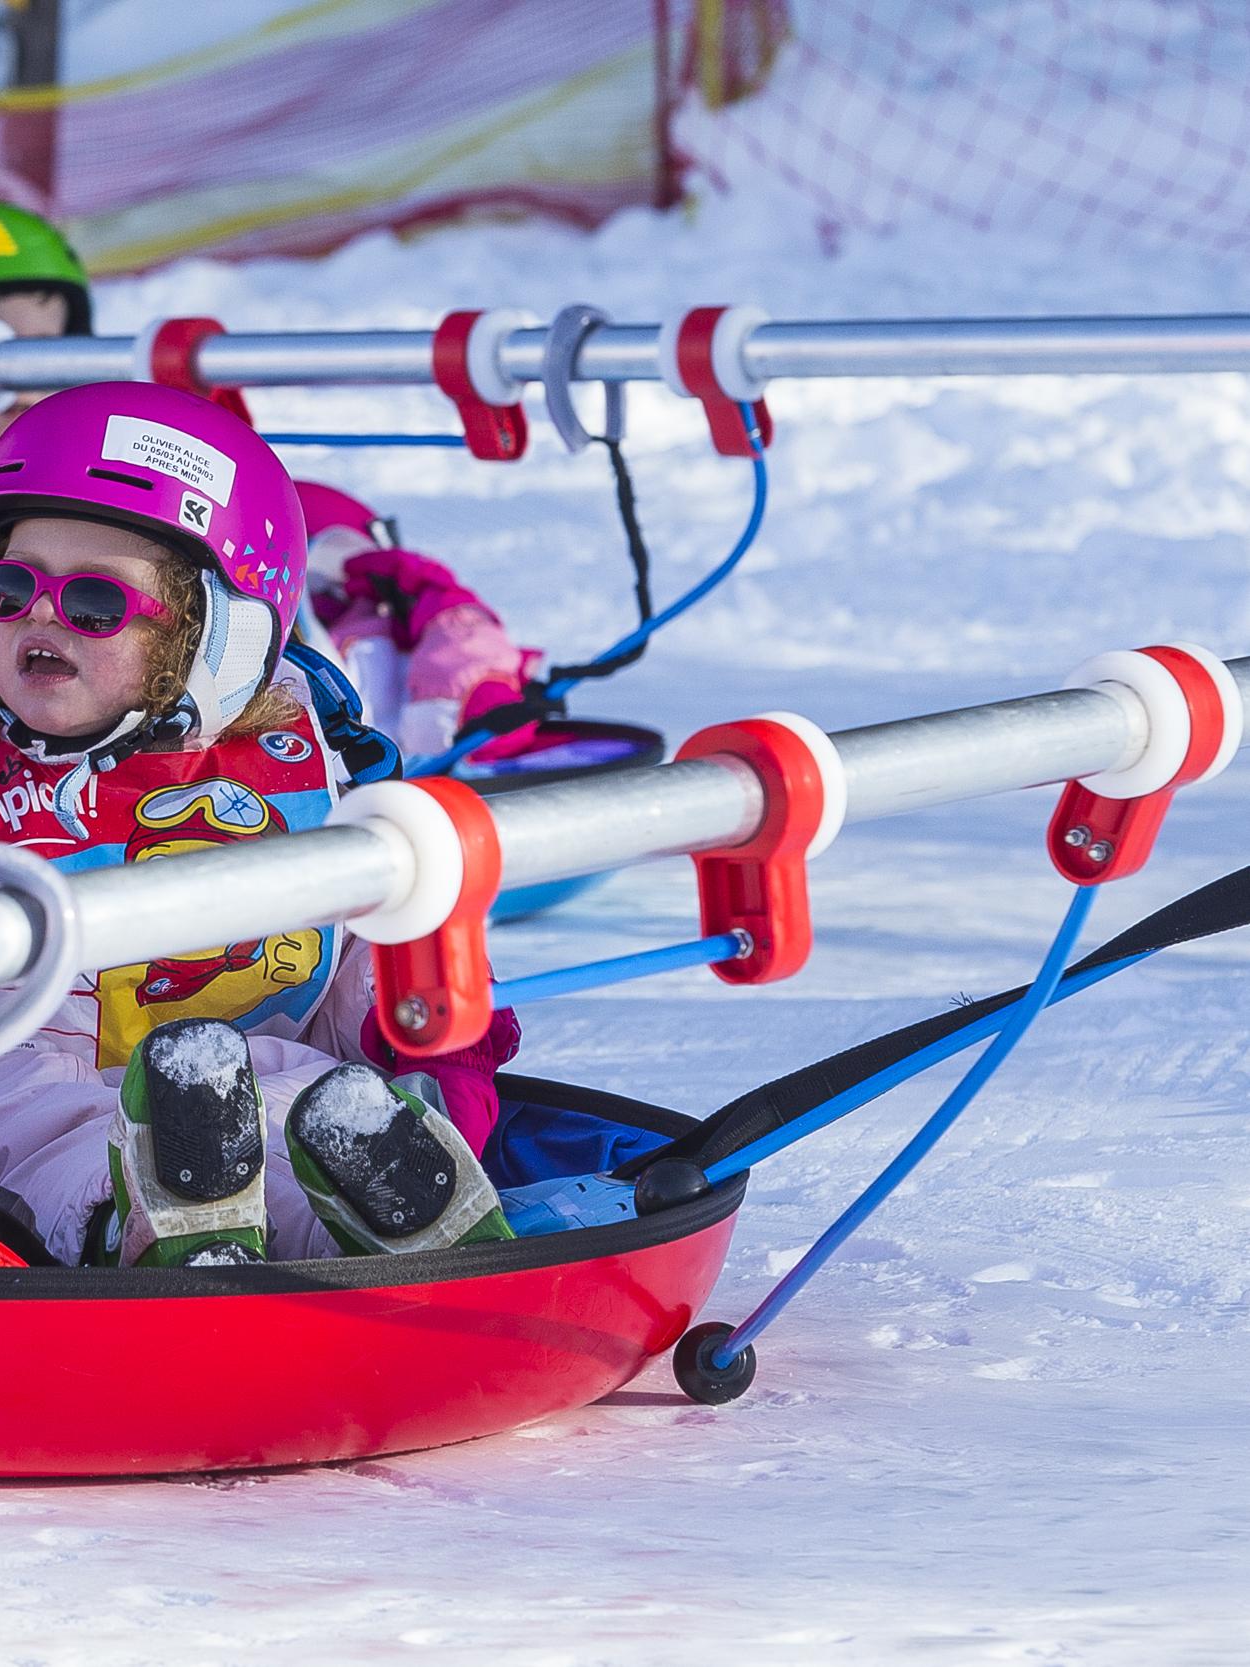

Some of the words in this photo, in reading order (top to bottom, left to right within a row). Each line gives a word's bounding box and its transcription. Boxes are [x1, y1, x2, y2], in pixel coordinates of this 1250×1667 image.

[132, 442, 148, 452] DU
[150, 446, 175, 461] 05/03
[176, 457, 190, 468] AU
[191, 465, 214, 482] 09/03
[142, 434, 182, 454] OLIVIER
[183, 449, 212, 468] ALICE
[145, 455, 179, 473] APRES
[180, 470, 200, 484] MIDI
